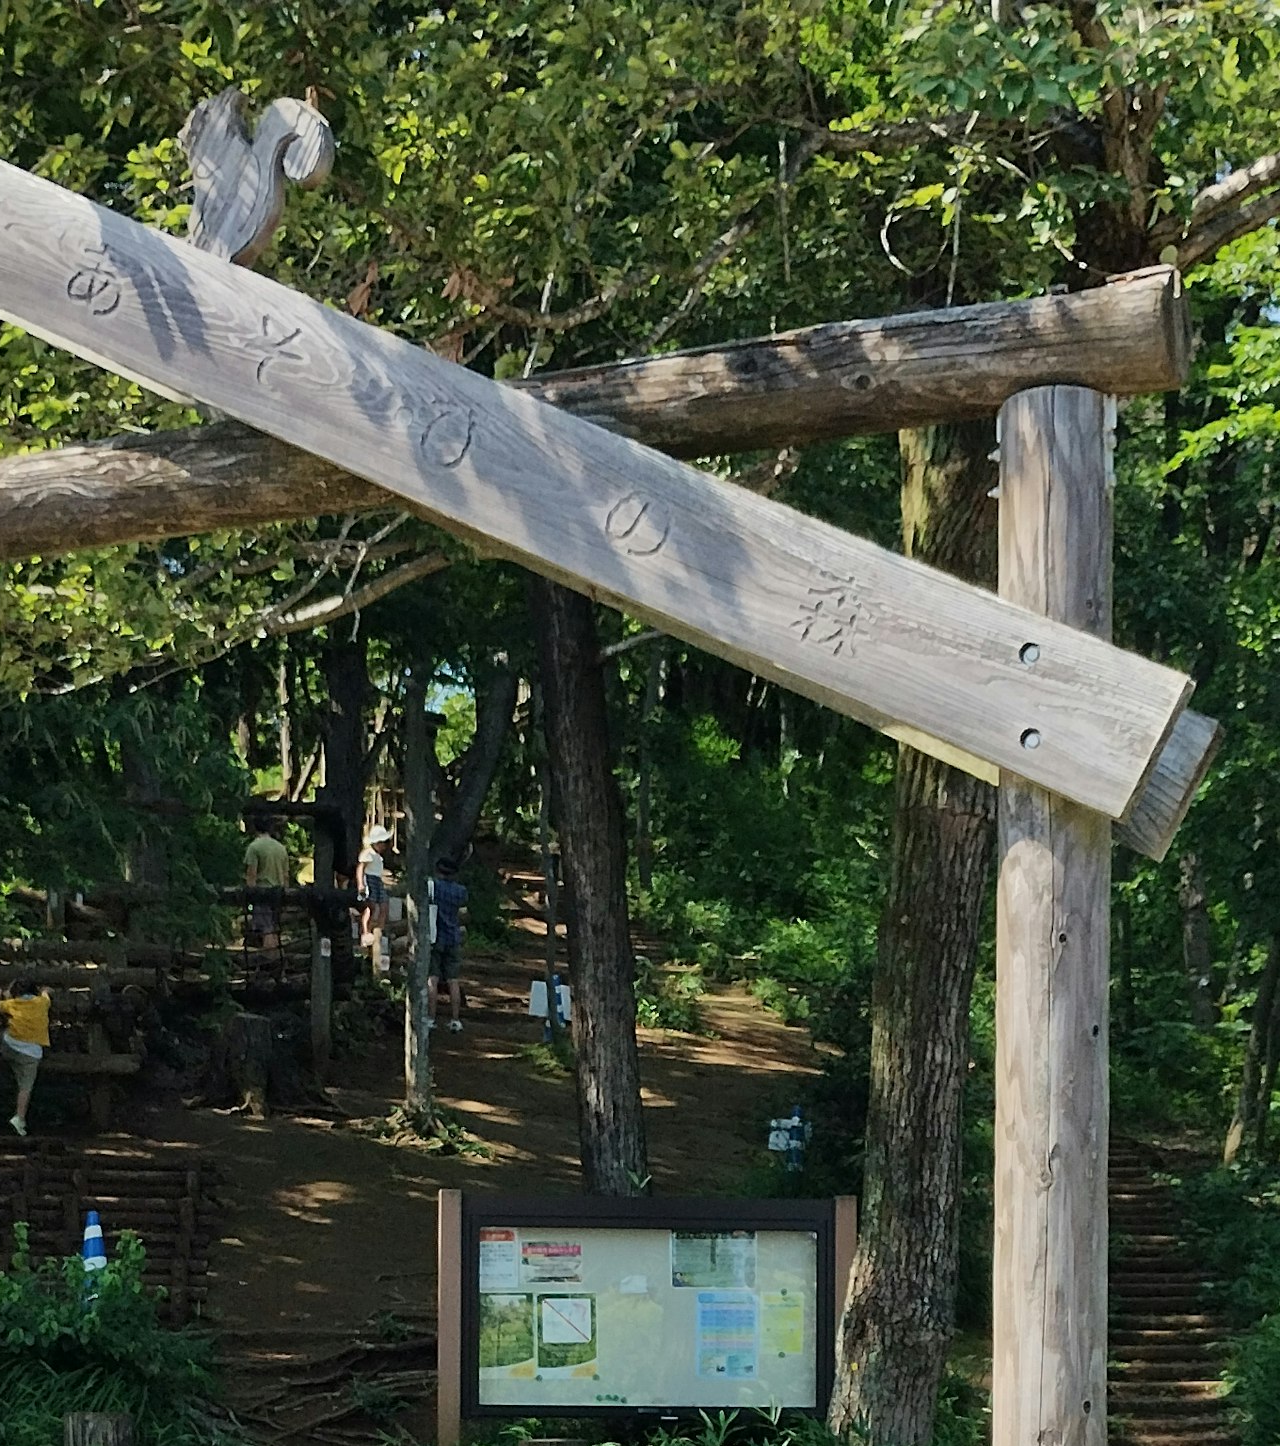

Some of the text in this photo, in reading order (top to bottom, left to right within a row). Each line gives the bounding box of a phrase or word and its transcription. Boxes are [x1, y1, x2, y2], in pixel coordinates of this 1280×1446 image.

[66, 242, 873, 658] あそびの森
